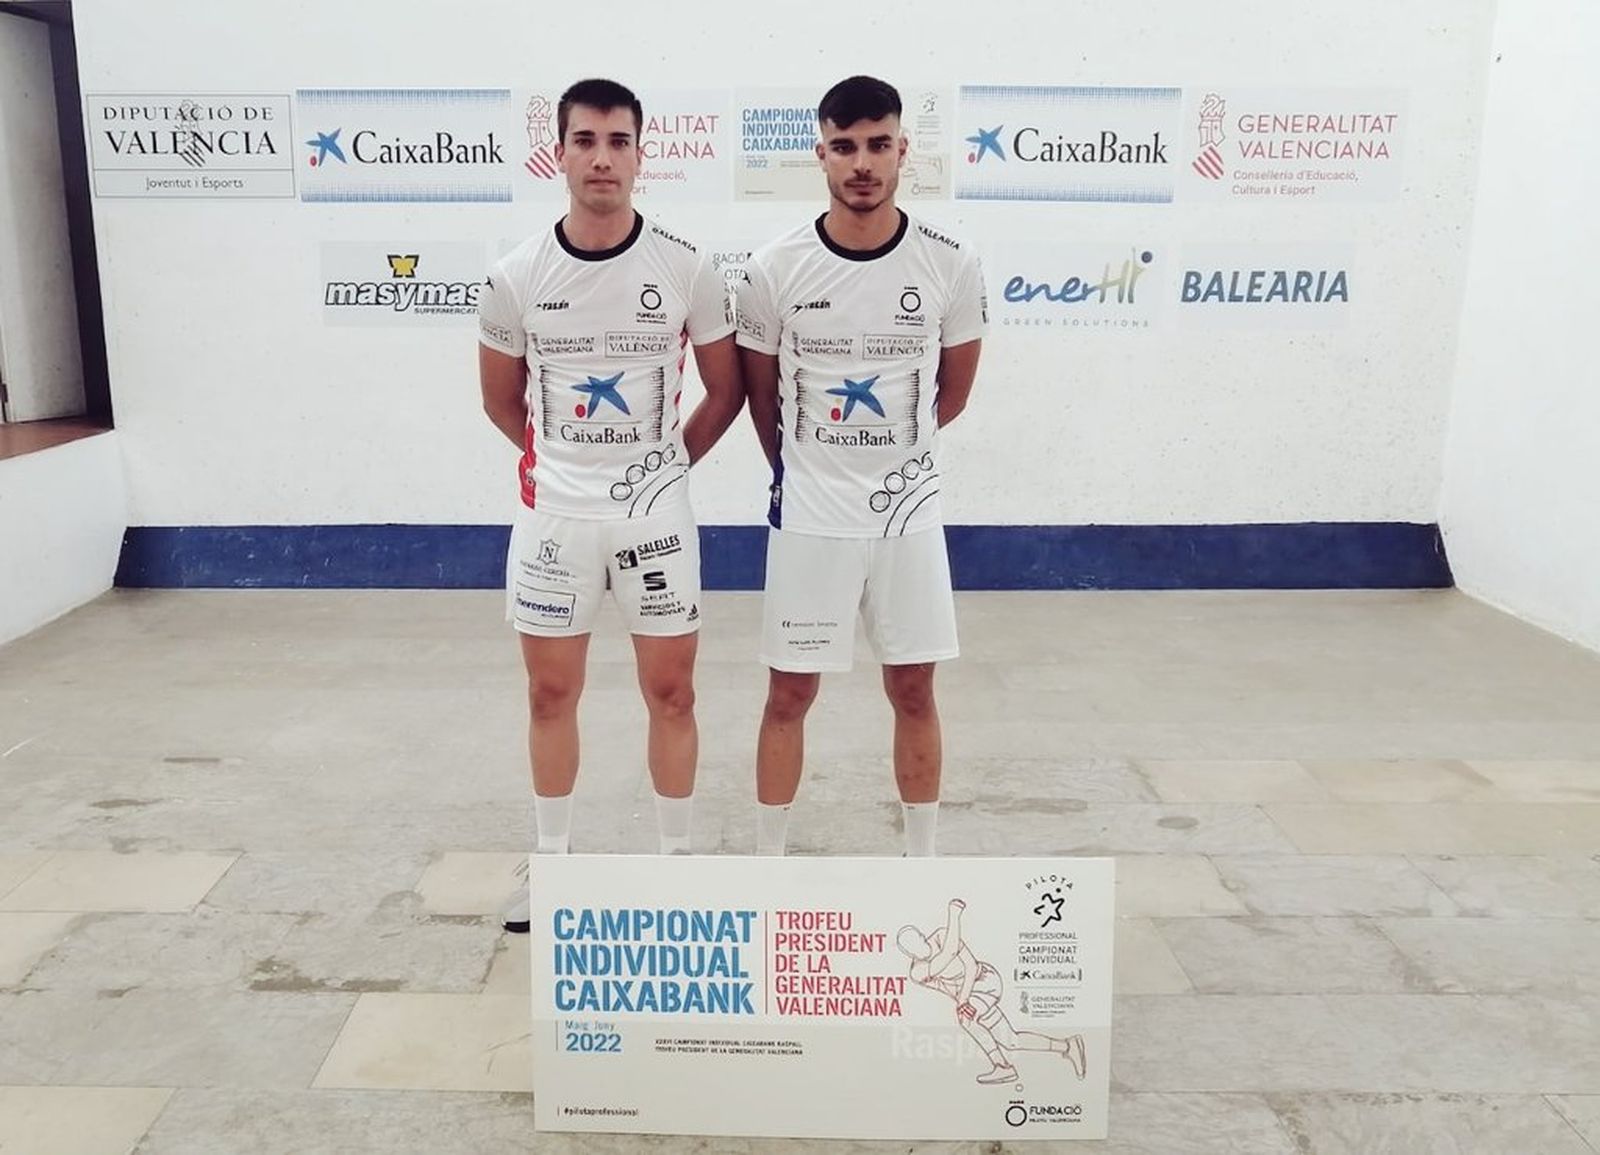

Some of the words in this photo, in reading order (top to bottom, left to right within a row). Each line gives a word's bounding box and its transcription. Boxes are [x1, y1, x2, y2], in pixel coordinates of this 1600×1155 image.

[103, 104, 233, 121] DIPUTACIÓ
[244, 106, 275, 121] DE
[742, 108, 819, 122] CAMPIONAT
[646, 115, 719, 134] ALITAT
[742, 123, 817, 136] INDIVIDUAL
[1237, 114, 1398, 135] GENERALITAT
[352, 130, 505, 166] CaixaBank
[642, 140, 715, 159] CIANA
[742, 138, 818, 151] CAIXABANK
[1013, 127, 1168, 165] CaixaBank
[1239, 140, 1390, 160] VALENCIANA
[746, 159, 768, 168] 2022
[146, 176, 192, 190] Joventut
[202, 177, 244, 191] Esports
[1232, 169, 1295, 181] Conselleria
[1232, 185, 1271, 196] Cultura
[1280, 185, 1316, 198] Esport
[713, 252, 746, 263] RACIÓ
[1180, 269, 1349, 303] BALEARIA
[325, 282, 481, 311] masymas
[414, 307, 480, 315] SUPERMERCAT
[1003, 318, 1053, 327] GREEN
[1063, 319, 1150, 328] SOLUTIONS
[540, 337, 595, 346] GENERALITAT
[801, 338, 854, 347] GENERALITAT
[561, 424, 642, 444] CaixaBank
[815, 427, 897, 447] CaixaBank
[637, 534, 681, 556] SALELLES
[1025, 875, 1073, 890] PILOTA
[553, 908, 757, 944] CAMPIONAT
[775, 911, 852, 931] TROFEU
[775, 933, 887, 953] PRESIDENT
[1018, 932, 1078, 940] PROFESSIONAL
[1019, 945, 1077, 954] CAMPIONAT
[554, 944, 749, 979] INDIVIDUAL
[775, 954, 800, 974] DE
[807, 955, 831, 974] LA
[1019, 955, 1076, 964] INDIVIDUAL
[1032, 969, 1076, 980] CaixaBank
[775, 975, 907, 996] GENERALITAT
[555, 979, 756, 1015] CAIXABANK
[775, 997, 903, 1017] VALENCIANA
[565, 1020, 589, 1031] Maig
[565, 1032, 622, 1053] 2022
[892, 1025, 973, 1064] Rasp
[1029, 1105, 1082, 1115] FUNDACIÓ
